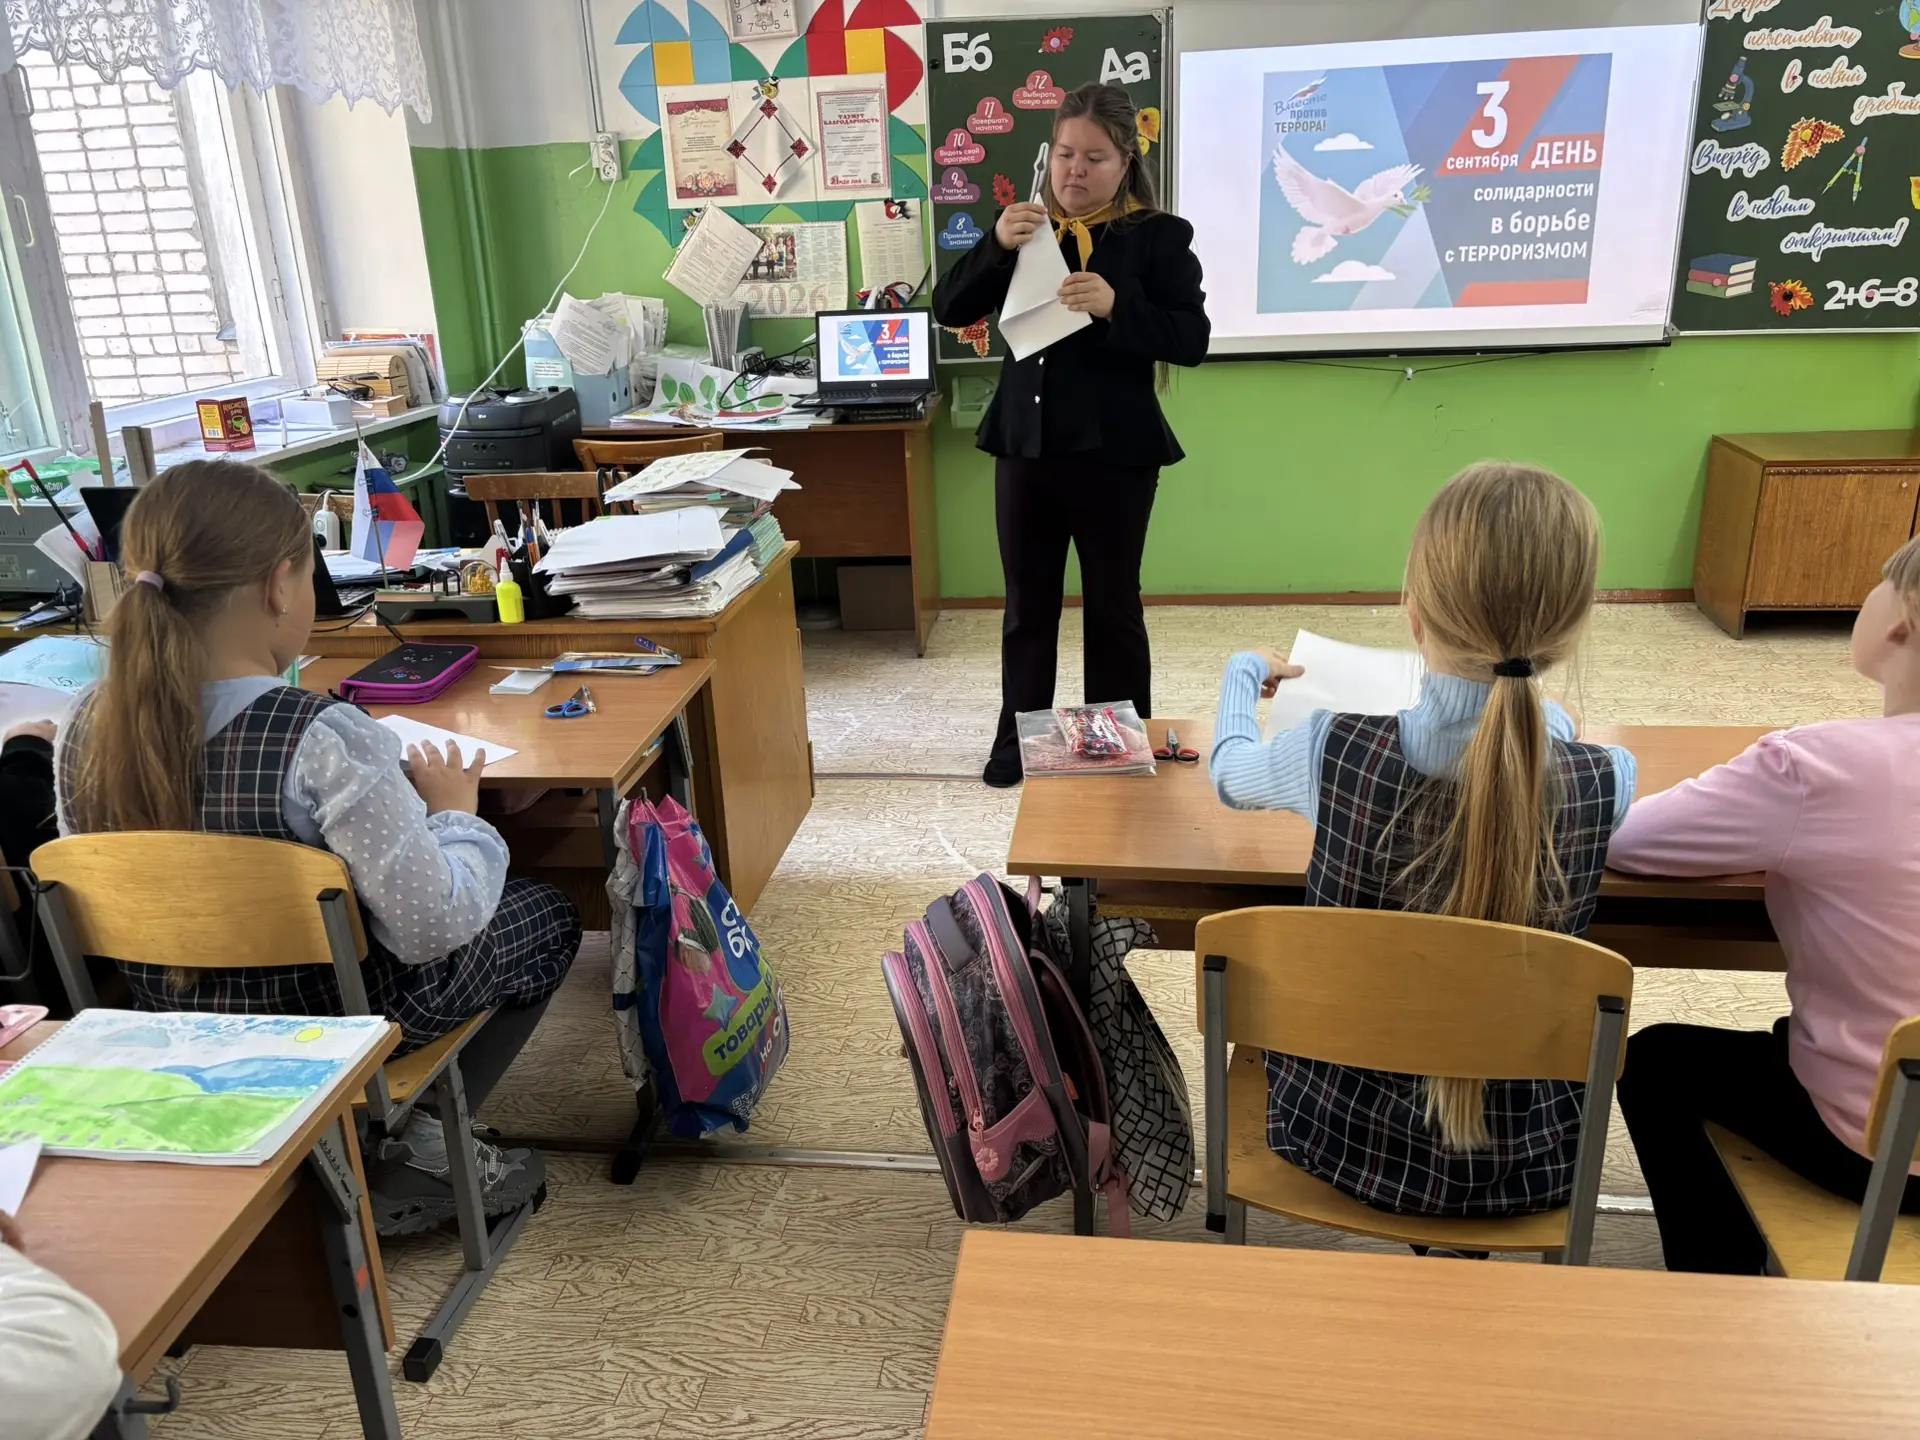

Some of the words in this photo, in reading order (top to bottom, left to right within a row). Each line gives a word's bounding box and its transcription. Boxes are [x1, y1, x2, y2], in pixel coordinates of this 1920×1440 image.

[736, 14, 743, 24] 8
[783, 9, 790, 18] 4
[748, 23, 755, 32] 7
[761, 21, 768, 31] 6
[774, 20, 781, 30] 5
[942, 32, 993, 73] Бб
[1100, 48, 1151, 85] Аа
[1810, 58, 1864, 85] новый
[1034, 75, 1048, 89] 12
[1022, 91, 1056, 99] Выбирать
[1273, 94, 1328, 115] Вместе
[1290, 107, 1327, 120] против
[1471, 80, 1510, 150] 3
[971, 118, 1009, 126] Завершать
[1275, 120, 1326, 134] ТЕРРОРА!
[953, 132, 966, 147] 10
[939, 149, 962, 157] Видеть
[963, 147, 980, 155] свой
[1446, 151, 1518, 170] сентября
[1530, 140, 1597, 169] ДЕНЬ
[943, 156, 975, 164] прогресс
[951, 172, 959, 185] 9
[1474, 183, 1594, 202] солидарности
[1752, 189, 1811, 215] новым
[956, 217, 965, 230] 8
[1491, 215, 1503, 234] в
[1509, 208, 1590, 236] борьбе
[1784, 222, 1904, 257] открытиям!
[1445, 249, 1454, 263] с
[1458, 241, 1587, 262] ТЕРРОРИЗМОМ
[747, 284, 829, 315] 2026
[1823, 277, 1919, 311] 2+6=8
[881, 323, 890, 339] 3
